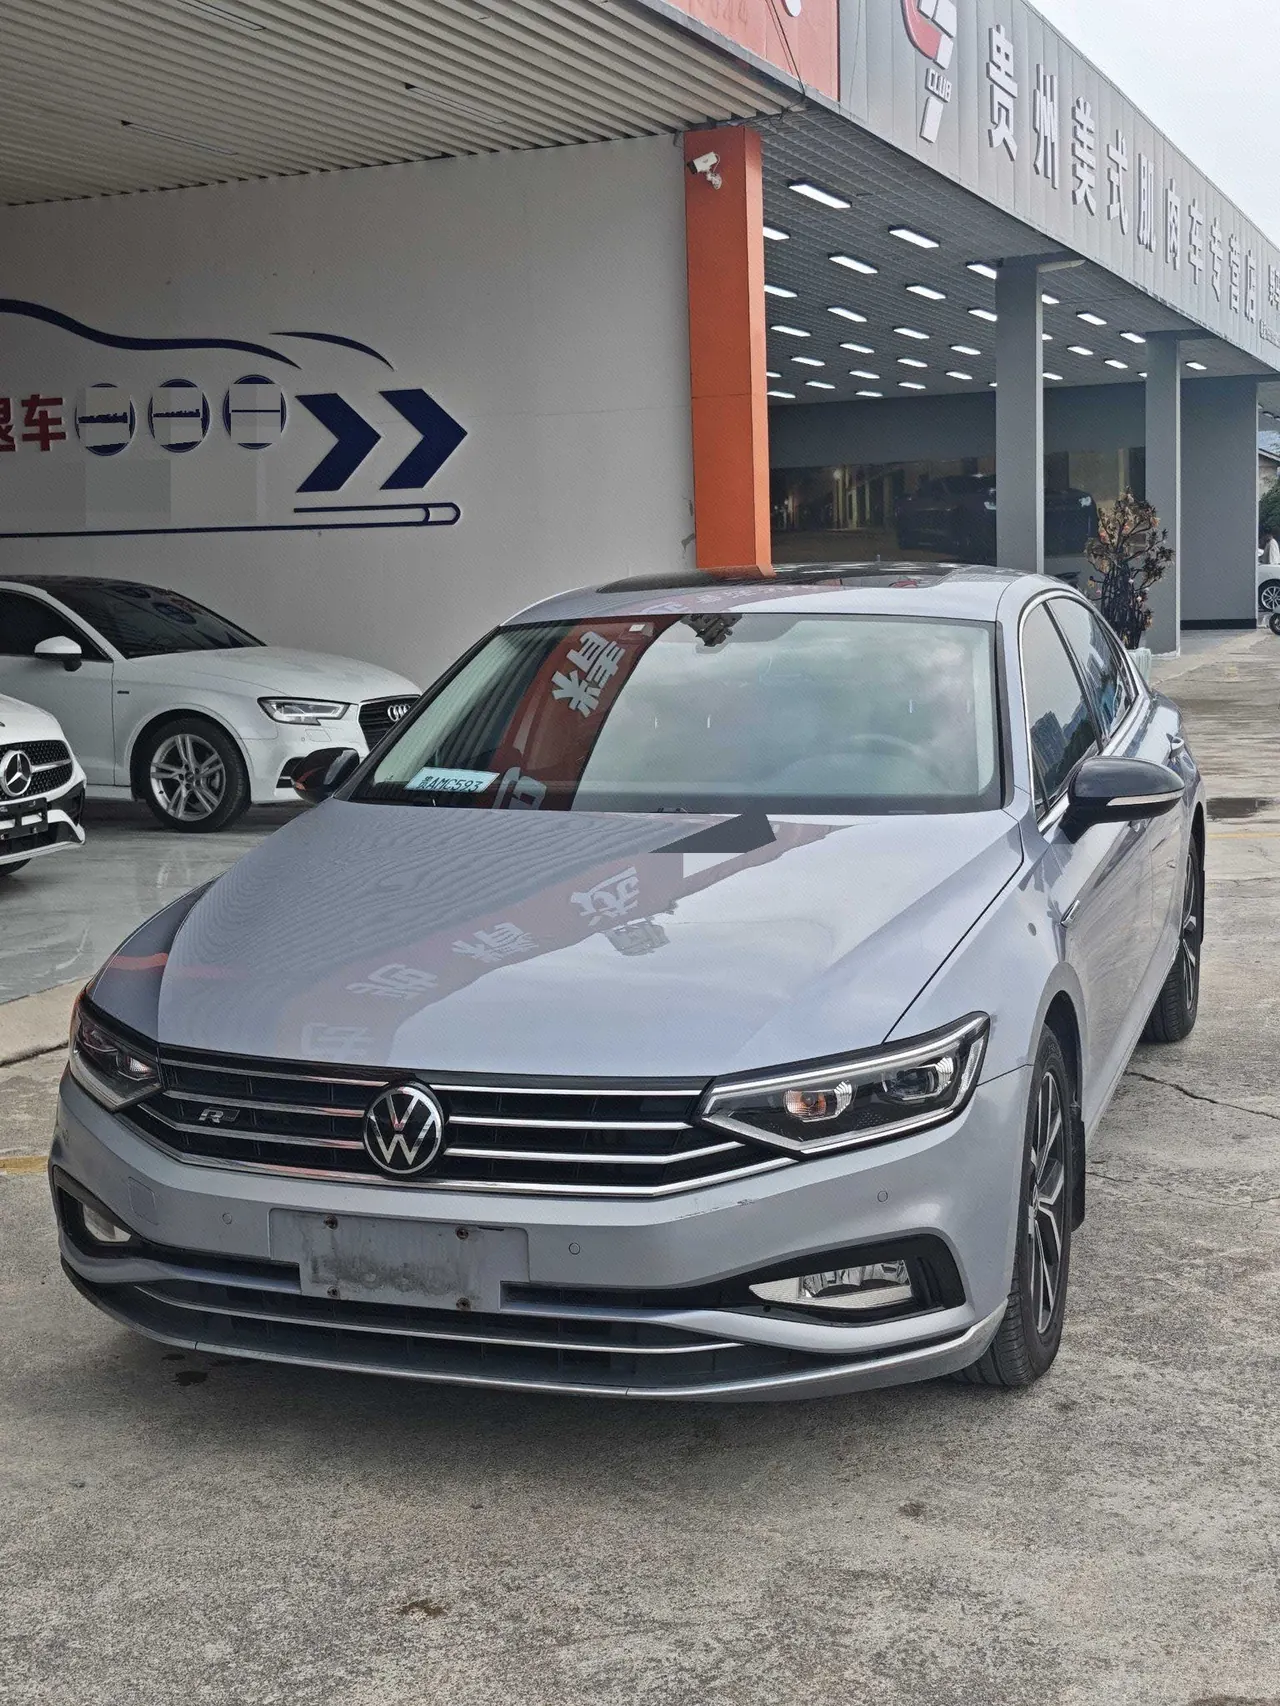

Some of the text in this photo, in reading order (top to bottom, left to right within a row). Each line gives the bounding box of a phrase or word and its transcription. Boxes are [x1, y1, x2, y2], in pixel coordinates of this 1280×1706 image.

[926, 68, 952, 103] CLUB
[986, 24, 1256, 325] 贵州美式肌肉车专营店
